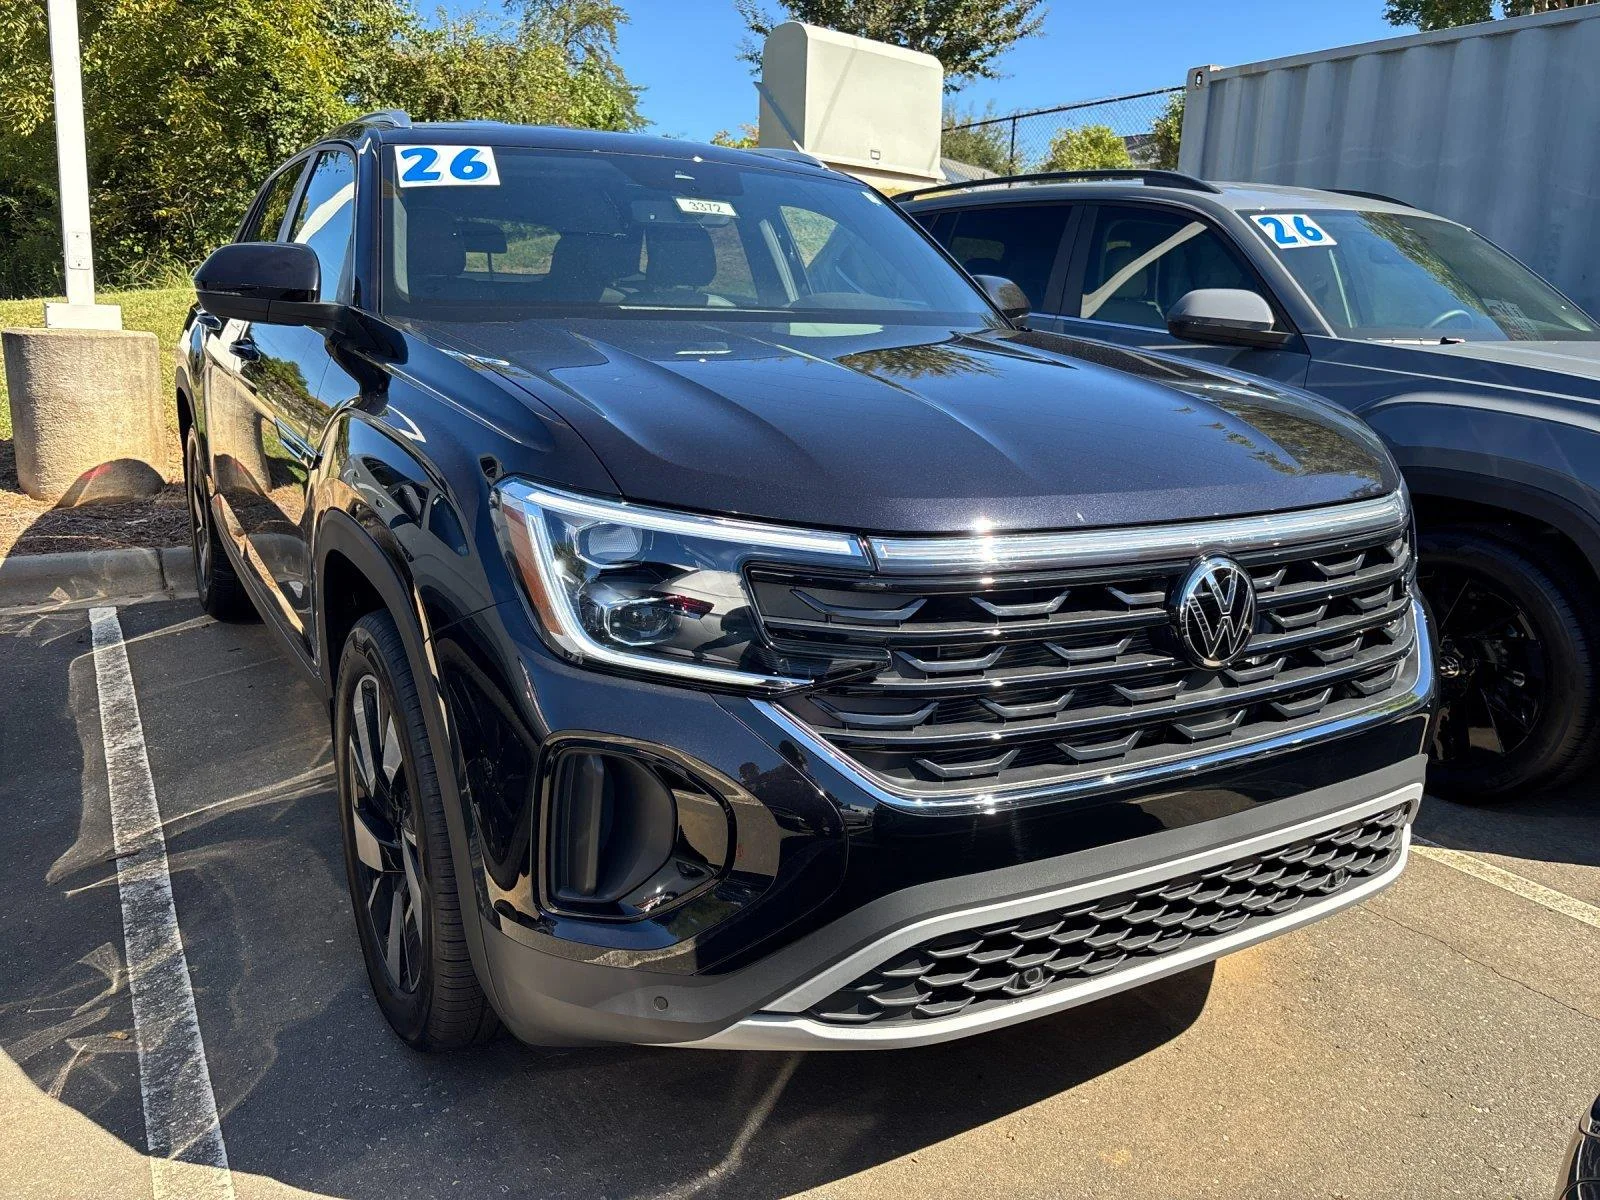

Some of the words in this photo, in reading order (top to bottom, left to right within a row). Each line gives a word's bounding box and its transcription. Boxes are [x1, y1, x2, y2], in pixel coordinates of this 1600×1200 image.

[400, 147, 487, 181] 26
[689, 201, 725, 213] 3372
[1257, 216, 1323, 244] 26
[1184, 564, 1253, 660] VW
